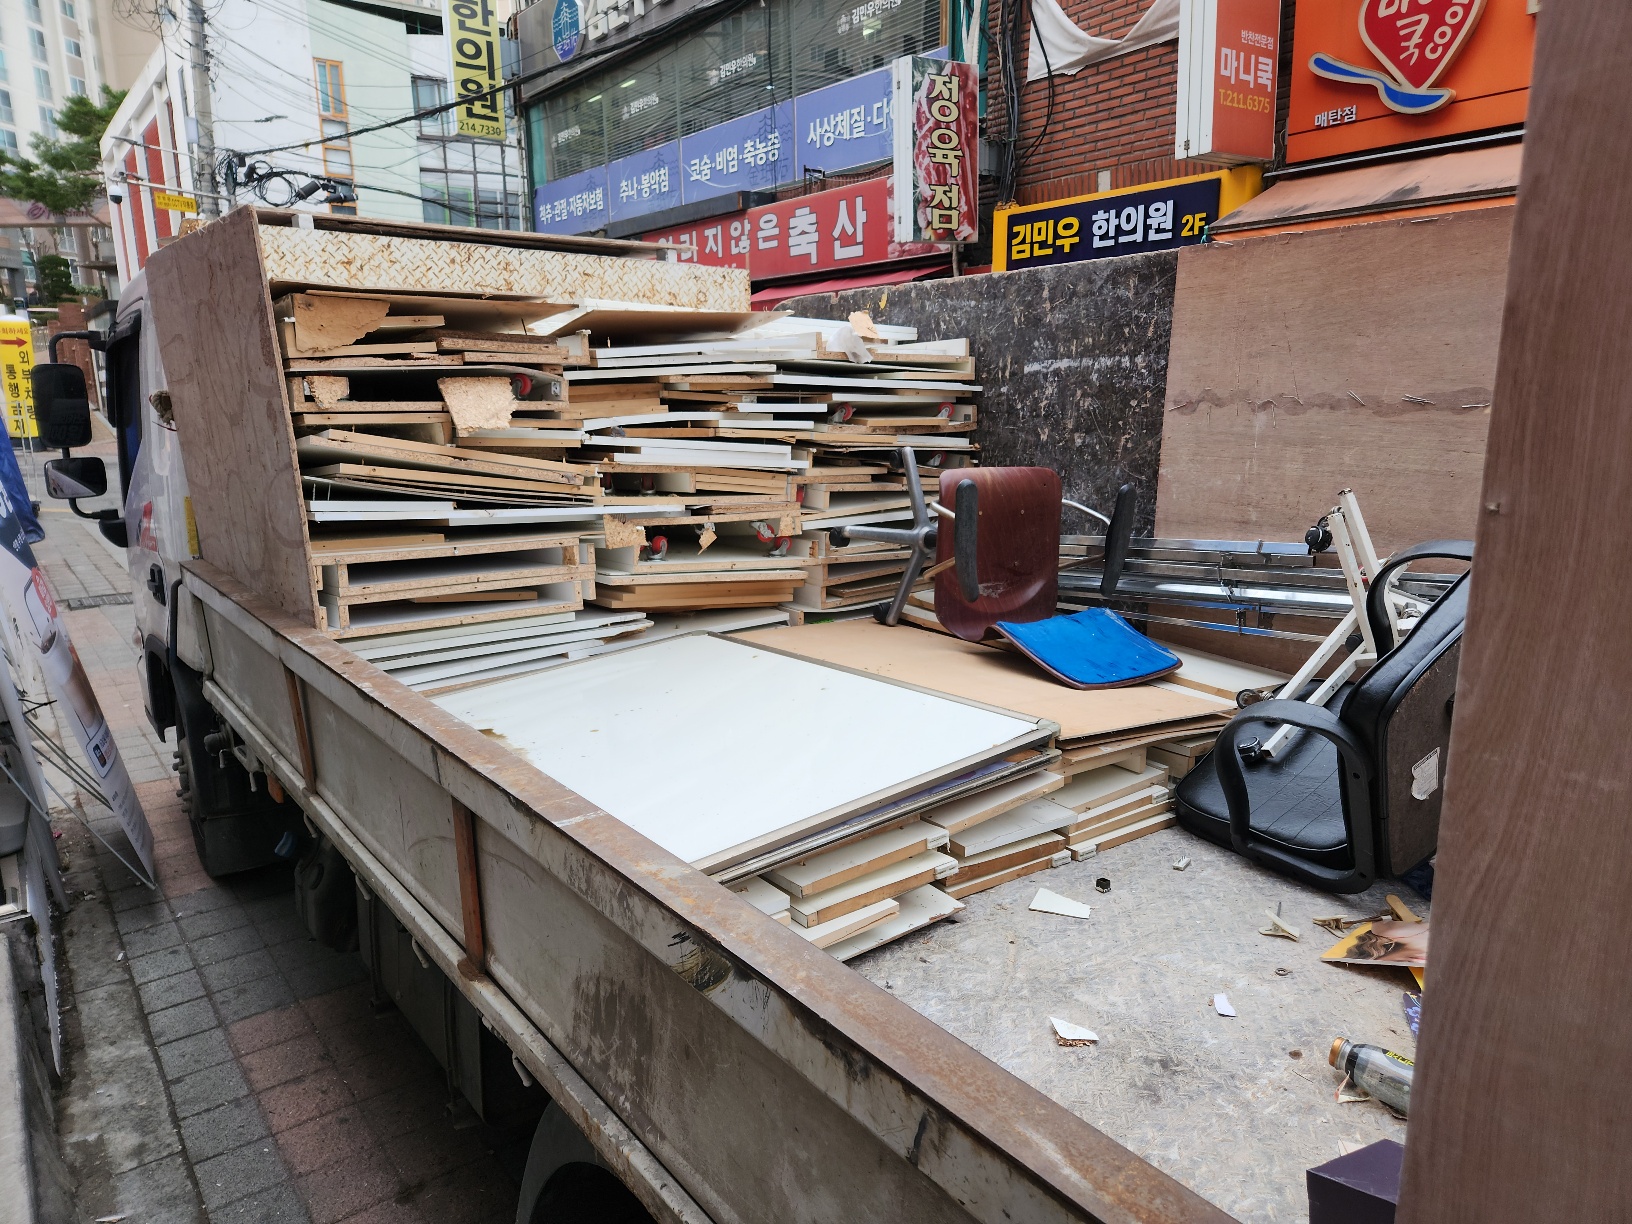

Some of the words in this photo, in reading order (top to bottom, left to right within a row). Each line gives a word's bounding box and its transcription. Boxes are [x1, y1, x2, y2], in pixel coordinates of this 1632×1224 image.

[1241, 29, 1274, 51] 반찬전문점
[1220, 47, 1273, 93] 마니쿡
[806, 97, 897, 149] 사상체질·다
[1219, 88, 1271, 114] T.211.6375
[1314, 104, 1357, 128] 매탄점
[459, 120, 502, 136] 214.7330
[925, 73, 965, 231] 정육점
[619, 166, 670, 203] 추나·봉약침
[788, 196, 867, 265] 축산
[1011, 216, 1080, 261] 김민우
[1091, 199, 1174, 249] 한의원
[1180, 212, 1207, 238] 2F
[5, 363, 26, 434] 통행금지
